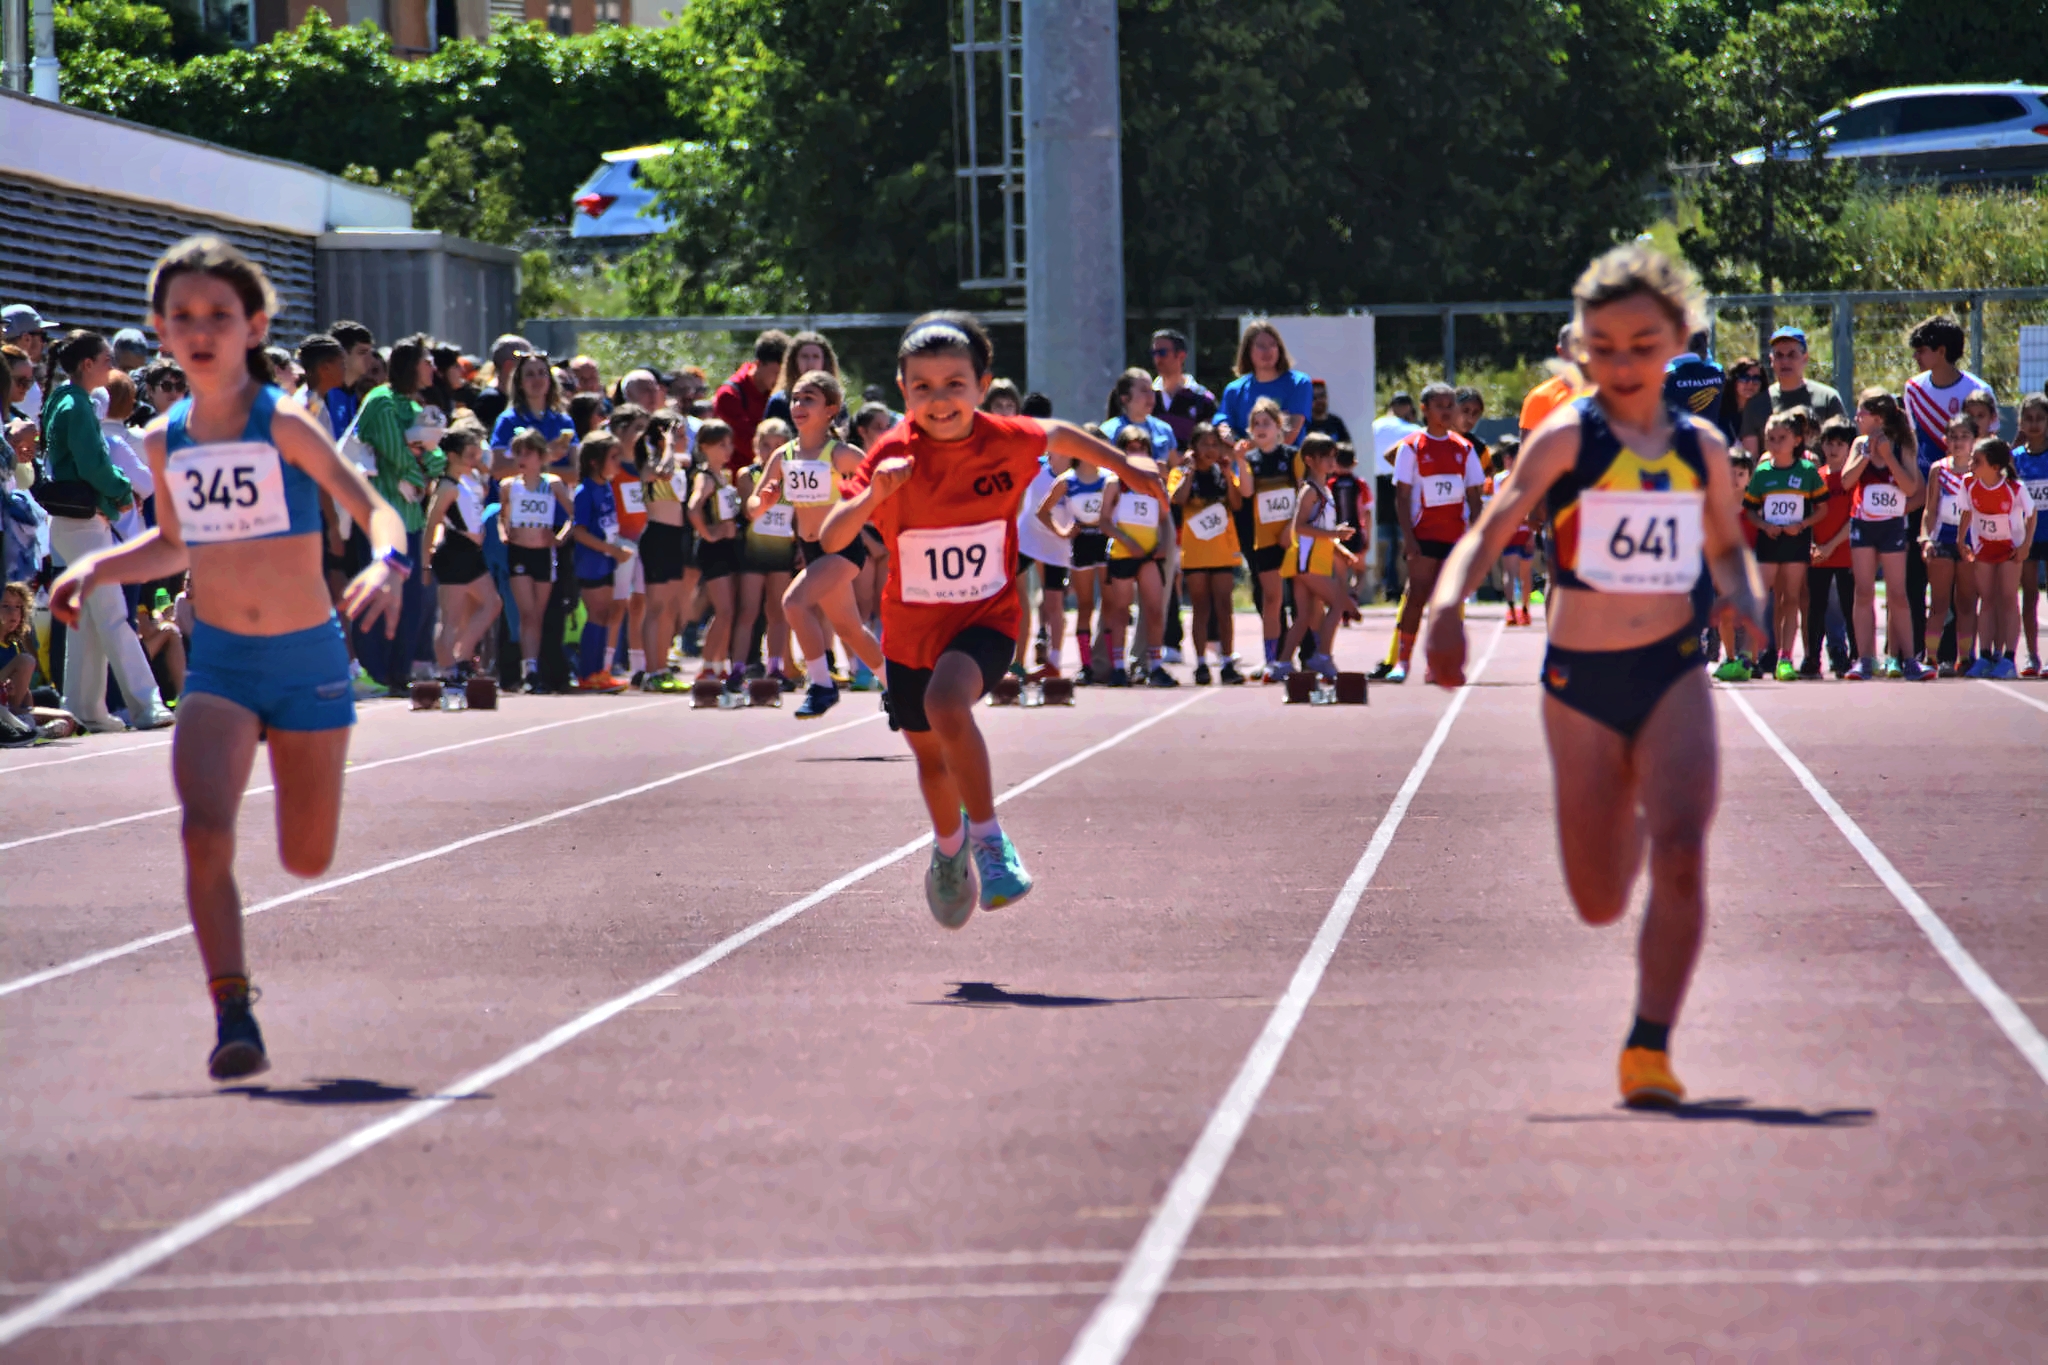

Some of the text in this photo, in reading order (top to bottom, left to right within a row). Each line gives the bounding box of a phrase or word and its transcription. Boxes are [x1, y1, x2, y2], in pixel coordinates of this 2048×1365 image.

[789, 471, 818, 489] 316
[186, 467, 258, 511] 345
[1435, 481, 1452, 496] 79
[521, 499, 548, 514] 500
[1265, 496, 1290, 512] 140
[1871, 492, 1897, 507] 586
[1771, 501, 1797, 516] 209
[1980, 519, 1997, 533] 73
[1609, 517, 1676, 560] 641
[924, 543, 986, 581] 109
